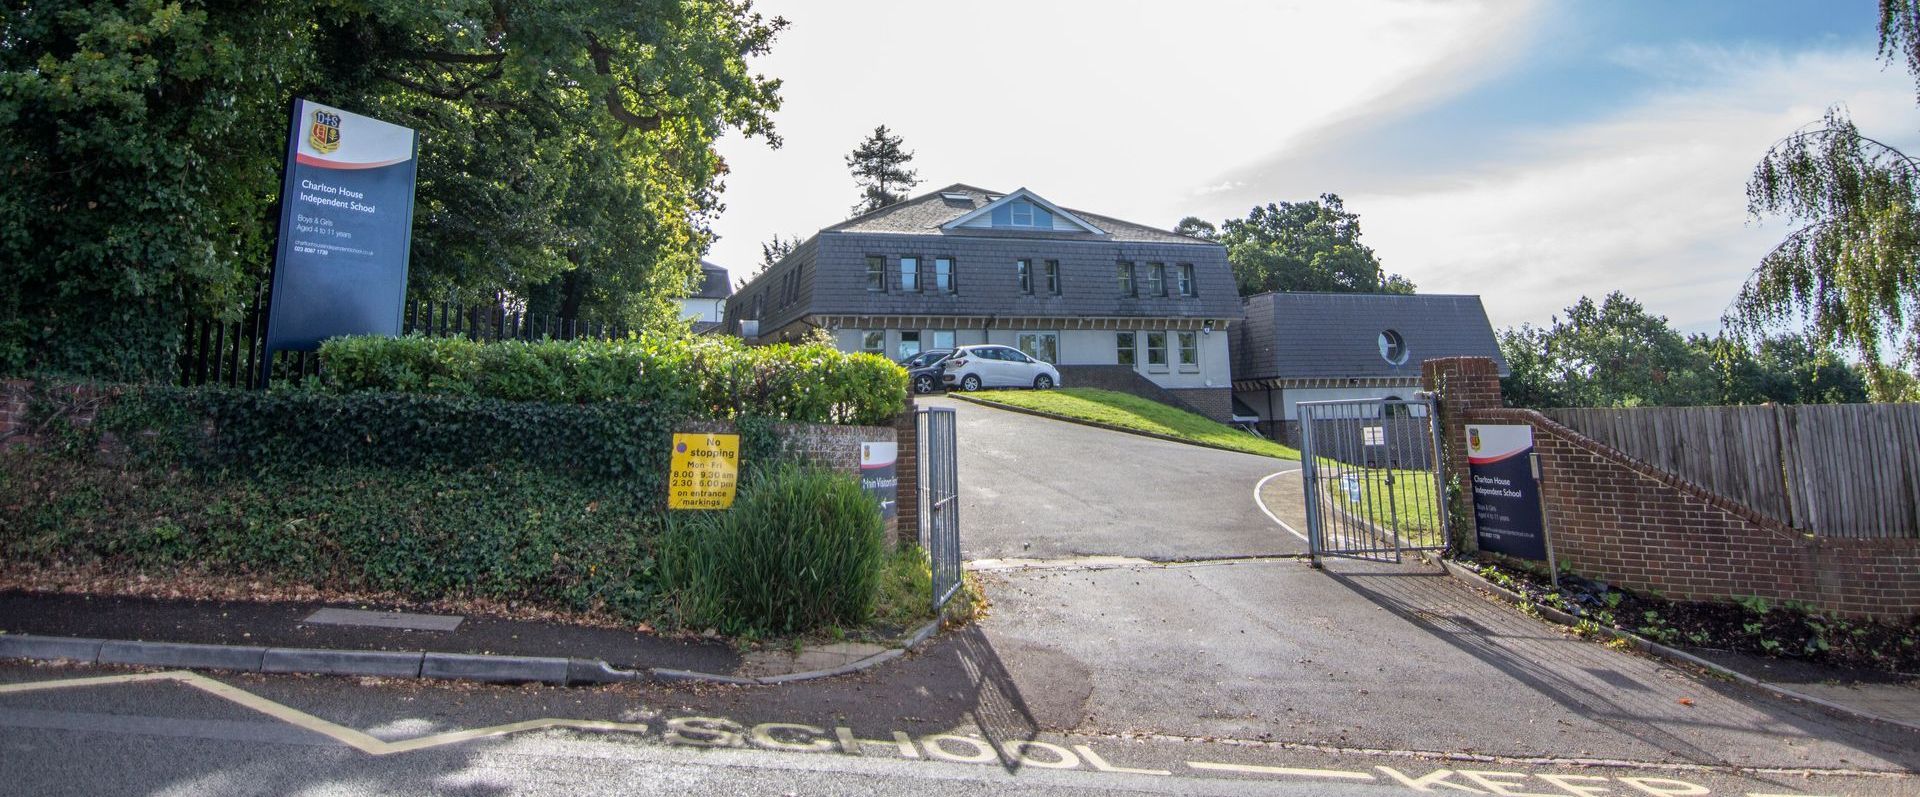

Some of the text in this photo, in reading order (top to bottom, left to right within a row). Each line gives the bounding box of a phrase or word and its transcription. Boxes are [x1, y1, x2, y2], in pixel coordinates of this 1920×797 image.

[302, 180, 364, 199] Charlton House
[300, 192, 376, 213] Independent School
[297, 214, 312, 224] Boys
[320, 218, 333, 227] Girls
[296, 224, 312, 232] Aged
[336, 231, 352, 239] years
[707, 438, 720, 446] No
[690, 449, 734, 458] stopping
[1474, 475, 1510, 485] Charlton House
[1475, 486, 1522, 497] Independent School
[665, 716, 1172, 775] SCHOOL
[1375, 765, 1711, 797] KEEP
